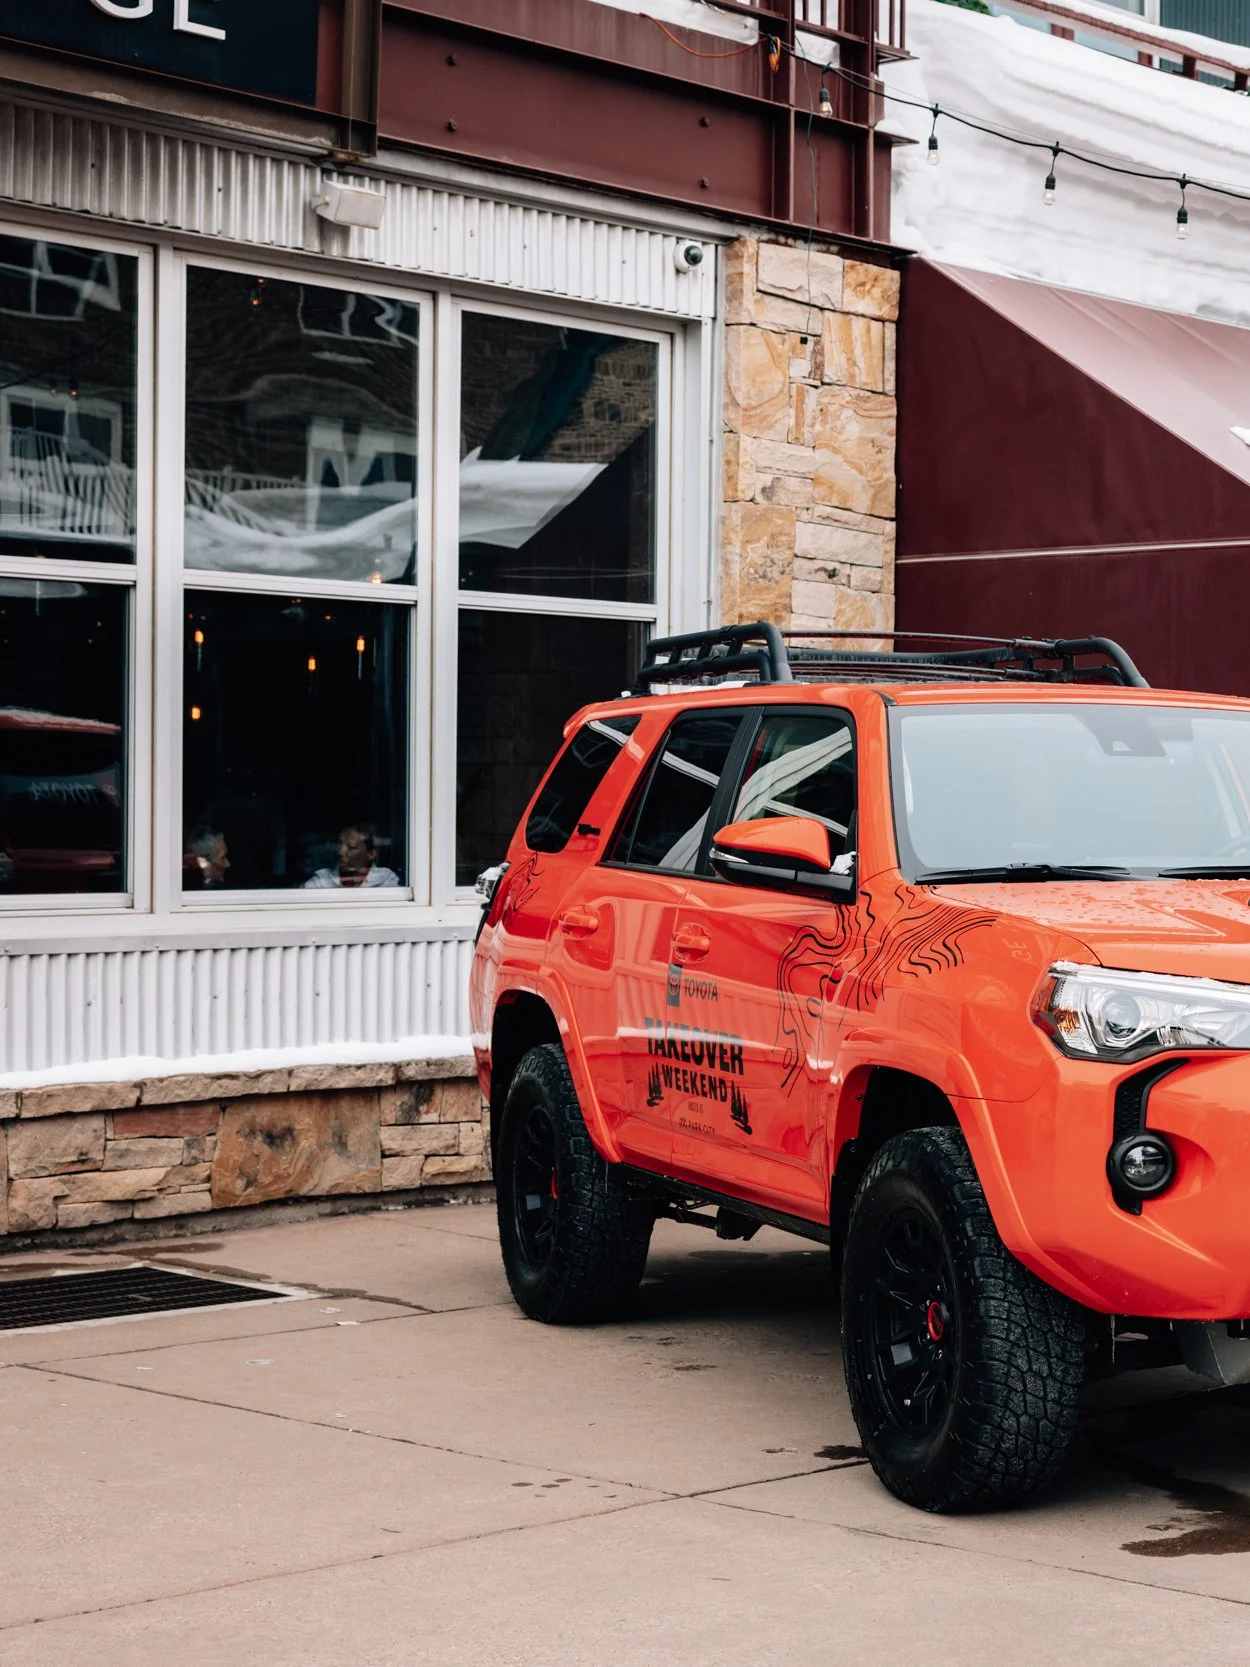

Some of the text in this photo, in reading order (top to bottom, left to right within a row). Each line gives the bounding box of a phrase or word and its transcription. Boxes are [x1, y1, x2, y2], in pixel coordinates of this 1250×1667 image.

[683, 977, 719, 1002] TOYOTA
[645, 1016, 745, 1076] TAKEOVER
[661, 1064, 728, 1103] WEEKEND
